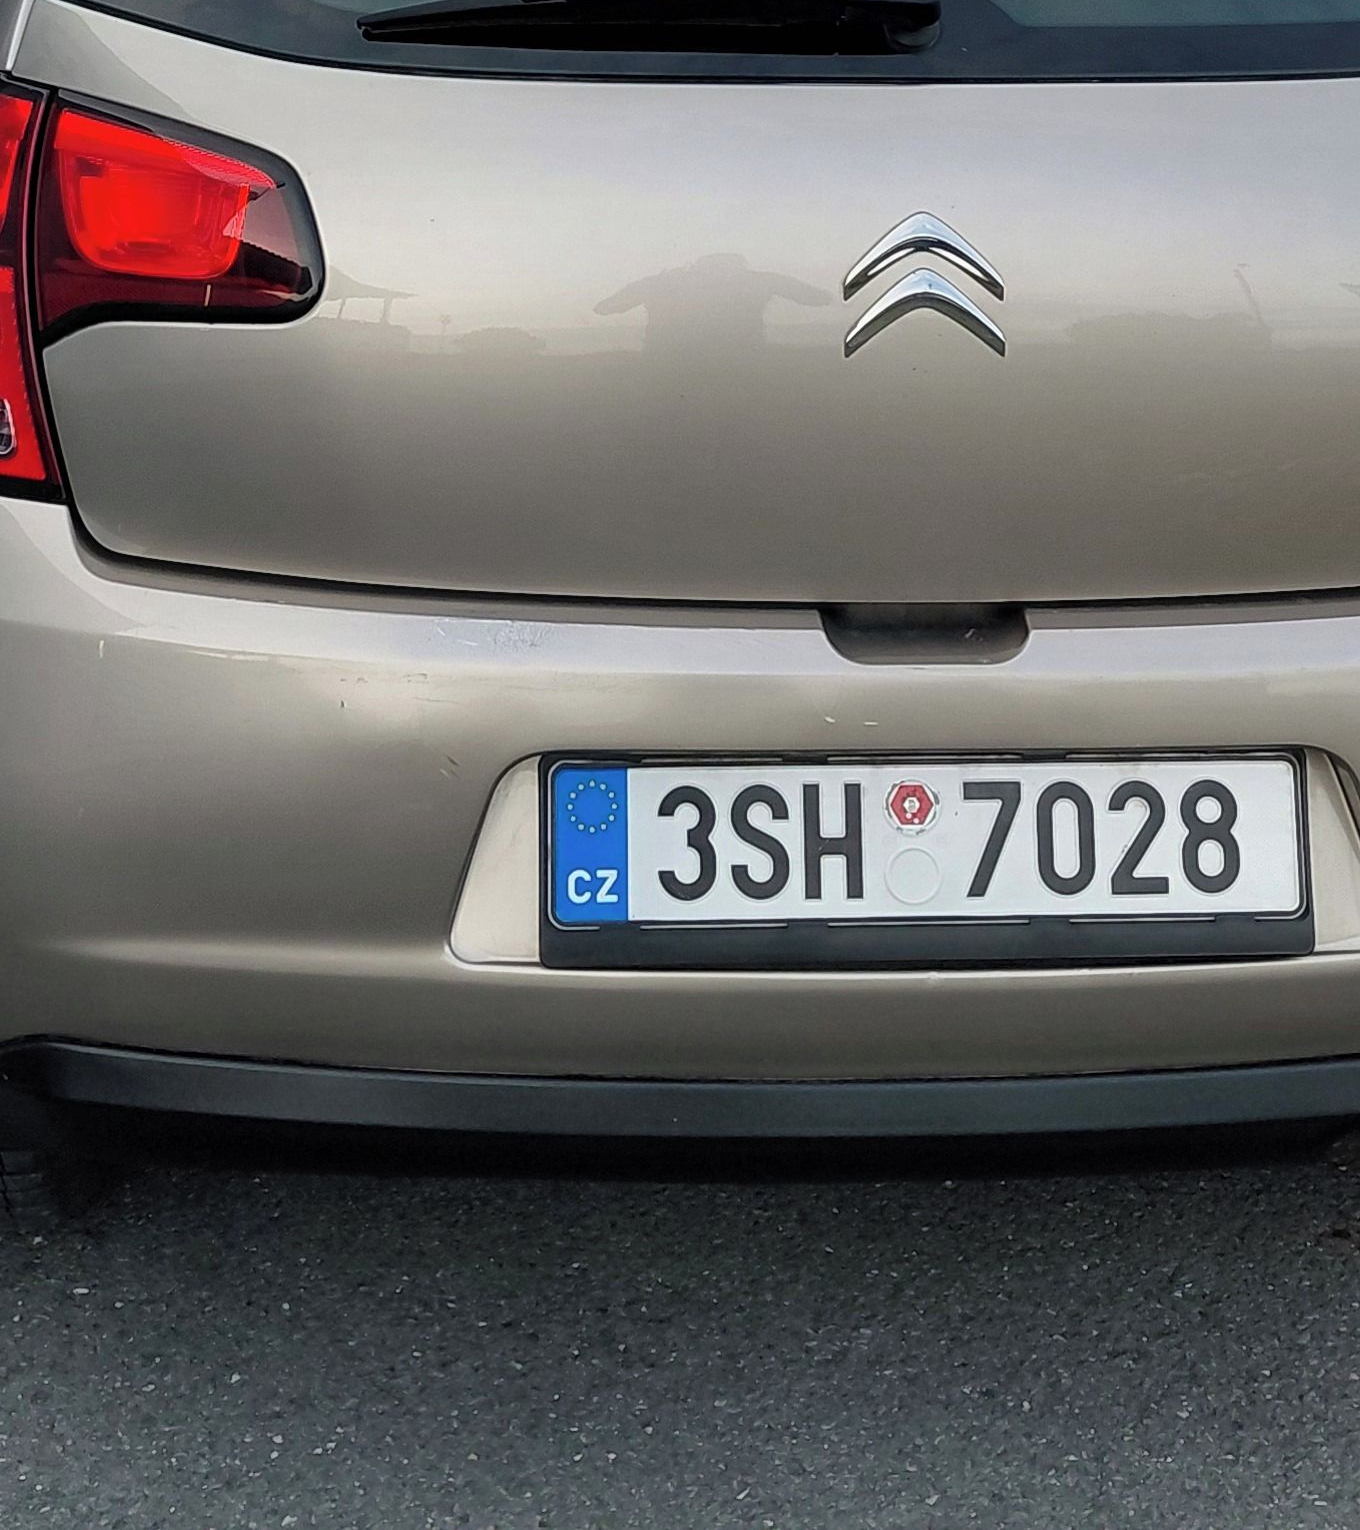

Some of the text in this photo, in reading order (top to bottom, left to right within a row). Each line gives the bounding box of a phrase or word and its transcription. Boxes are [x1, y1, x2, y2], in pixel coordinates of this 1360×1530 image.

[656, 779, 1238, 901] 3SH 7028
[566, 869, 620, 904] CZ
